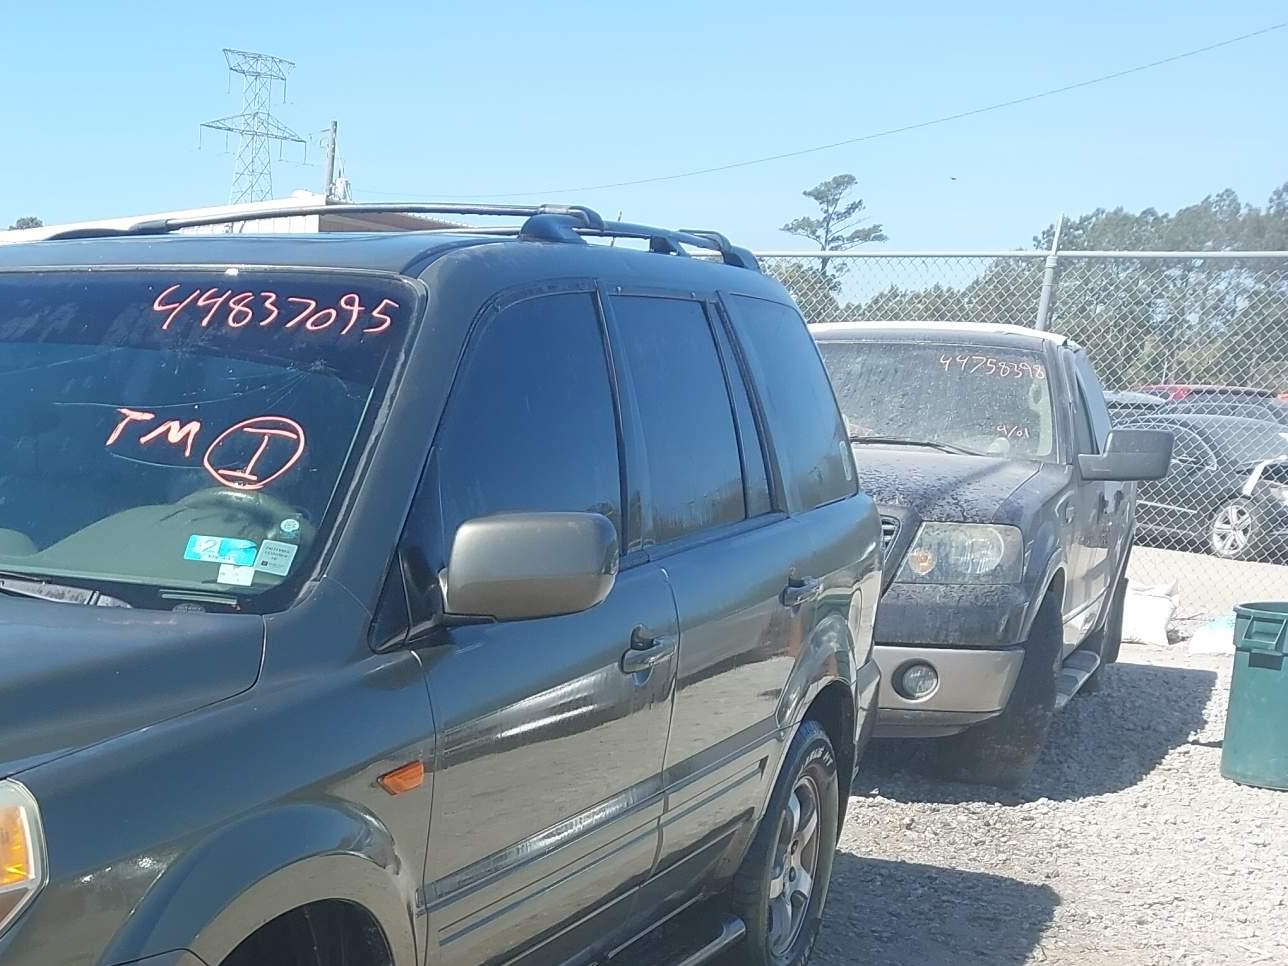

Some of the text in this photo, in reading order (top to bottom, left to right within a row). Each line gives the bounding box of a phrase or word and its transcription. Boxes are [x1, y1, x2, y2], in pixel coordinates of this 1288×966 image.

[152, 284, 400, 335] 44837095
[939, 354, 1045, 379] 44758398
[105, 407, 201, 457] TM
